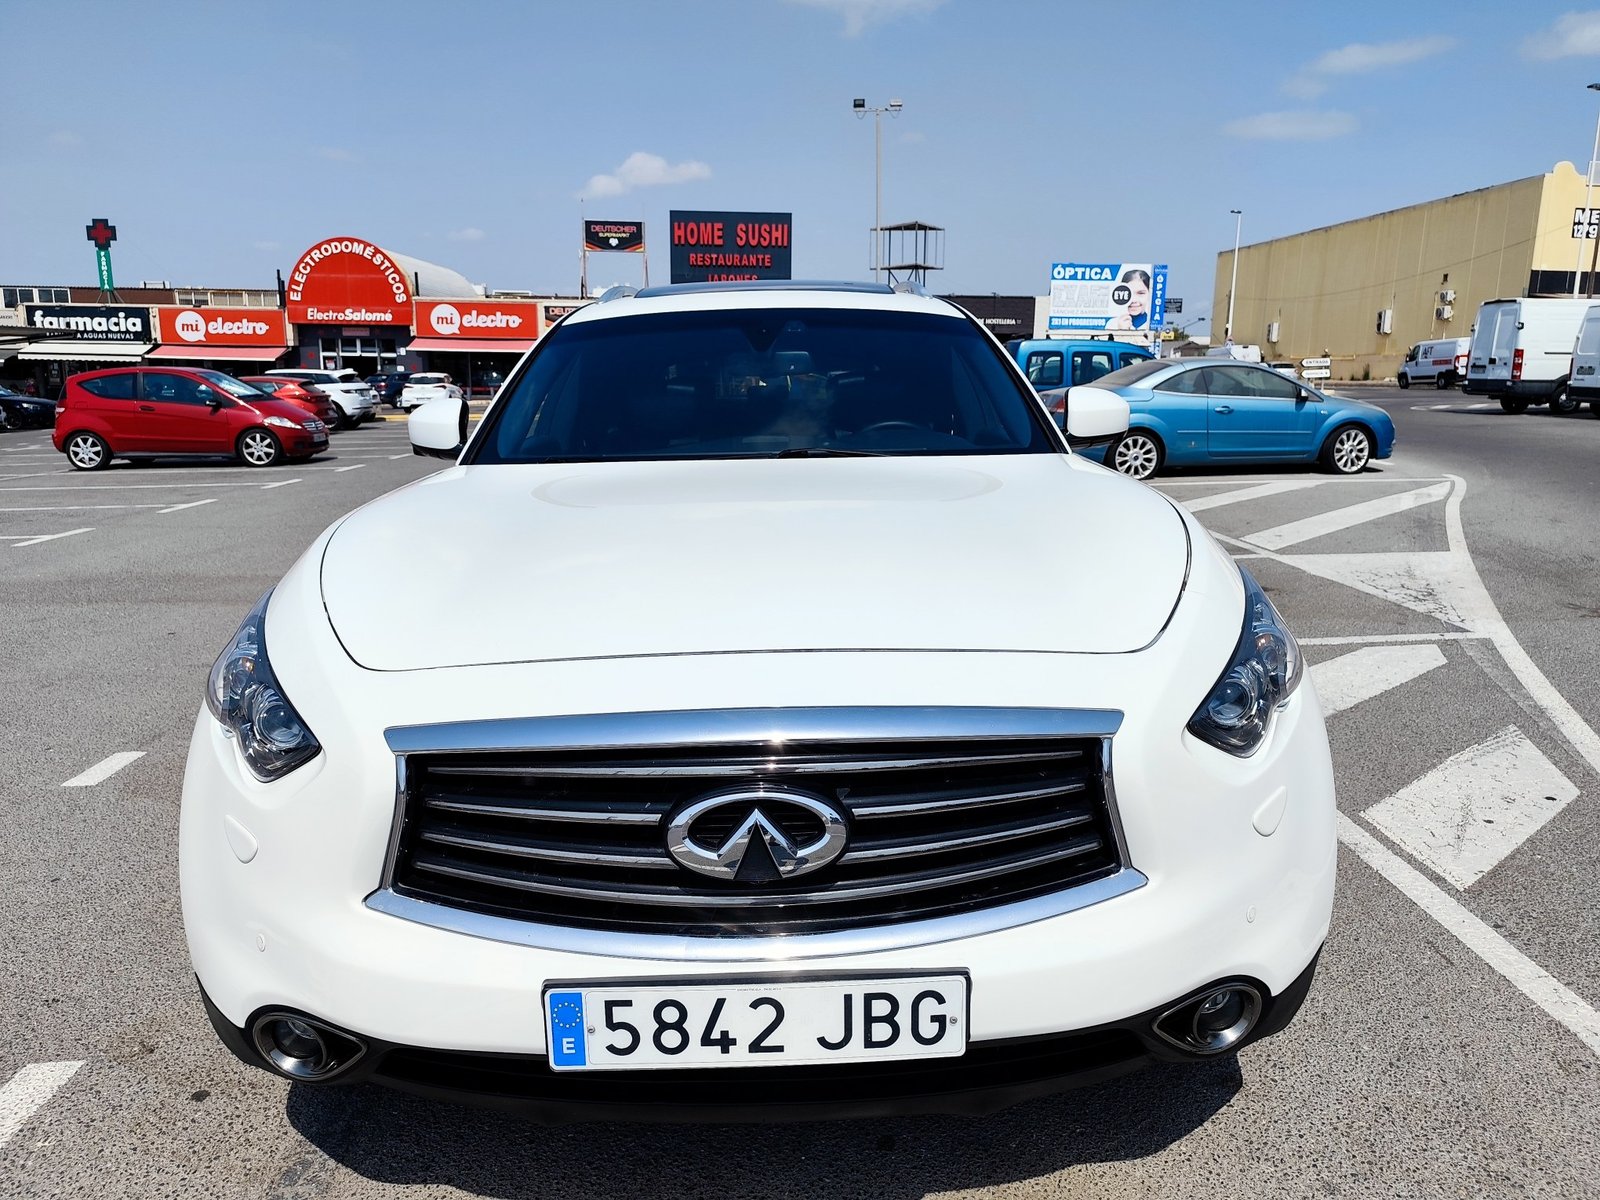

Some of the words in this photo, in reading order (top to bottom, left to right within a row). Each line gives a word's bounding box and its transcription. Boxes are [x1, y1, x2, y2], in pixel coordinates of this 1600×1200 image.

[591, 225, 637, 233] DEUTSCHER
[673, 221, 724, 246] HOME
[736, 223, 789, 248] SUSHI
[689, 253, 772, 267] RESTAURANTE
[100, 251, 109, 289] FARMACIA
[1052, 264, 1112, 280] ÓPTICA
[33, 309, 143, 332] farmacia
[307, 307, 393, 322] ElectroSalomé
[436, 313, 454, 325] mi
[462, 309, 522, 328] electro
[181, 320, 200, 332] mi
[207, 317, 269, 335] electro
[603, 996, 785, 1056] 5842
[816, 989, 948, 1051] JBG
[562, 1037, 576, 1054] E
